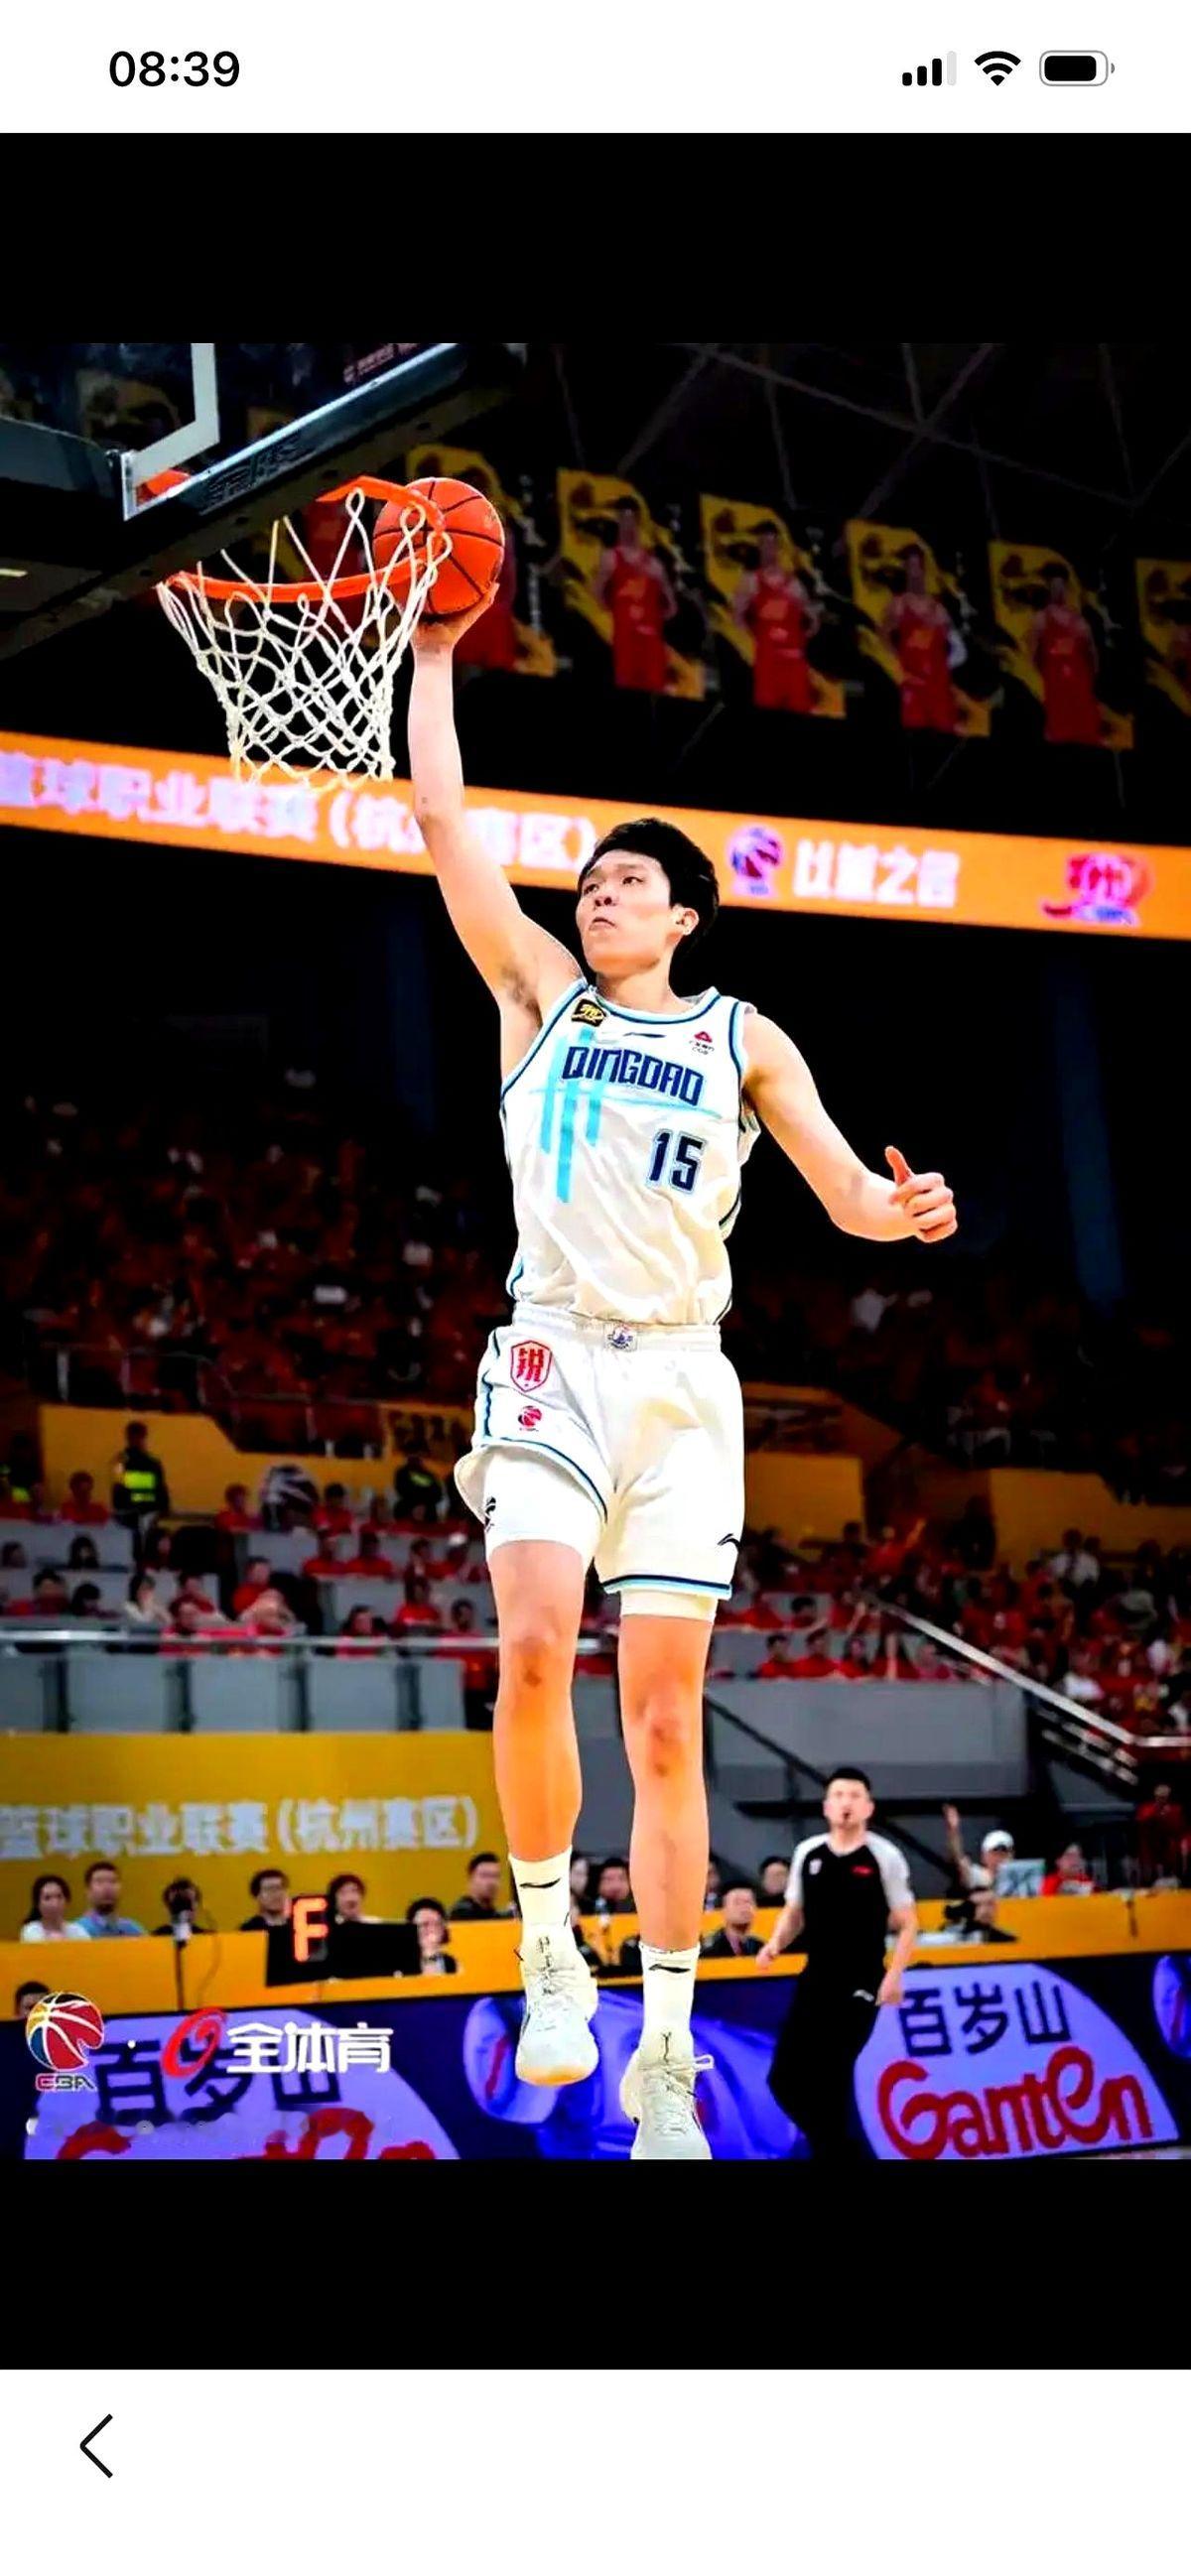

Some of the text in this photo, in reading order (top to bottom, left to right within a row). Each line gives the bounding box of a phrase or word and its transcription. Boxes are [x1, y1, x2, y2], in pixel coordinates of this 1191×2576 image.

[562, 1046, 704, 1106] QINGDAO
[646, 1128, 707, 1194] 15
[292, 1896, 328, 1963] F
[899, 1981, 1072, 2057] 百岁山
[877, 2046, 1153, 2160] Ganten
